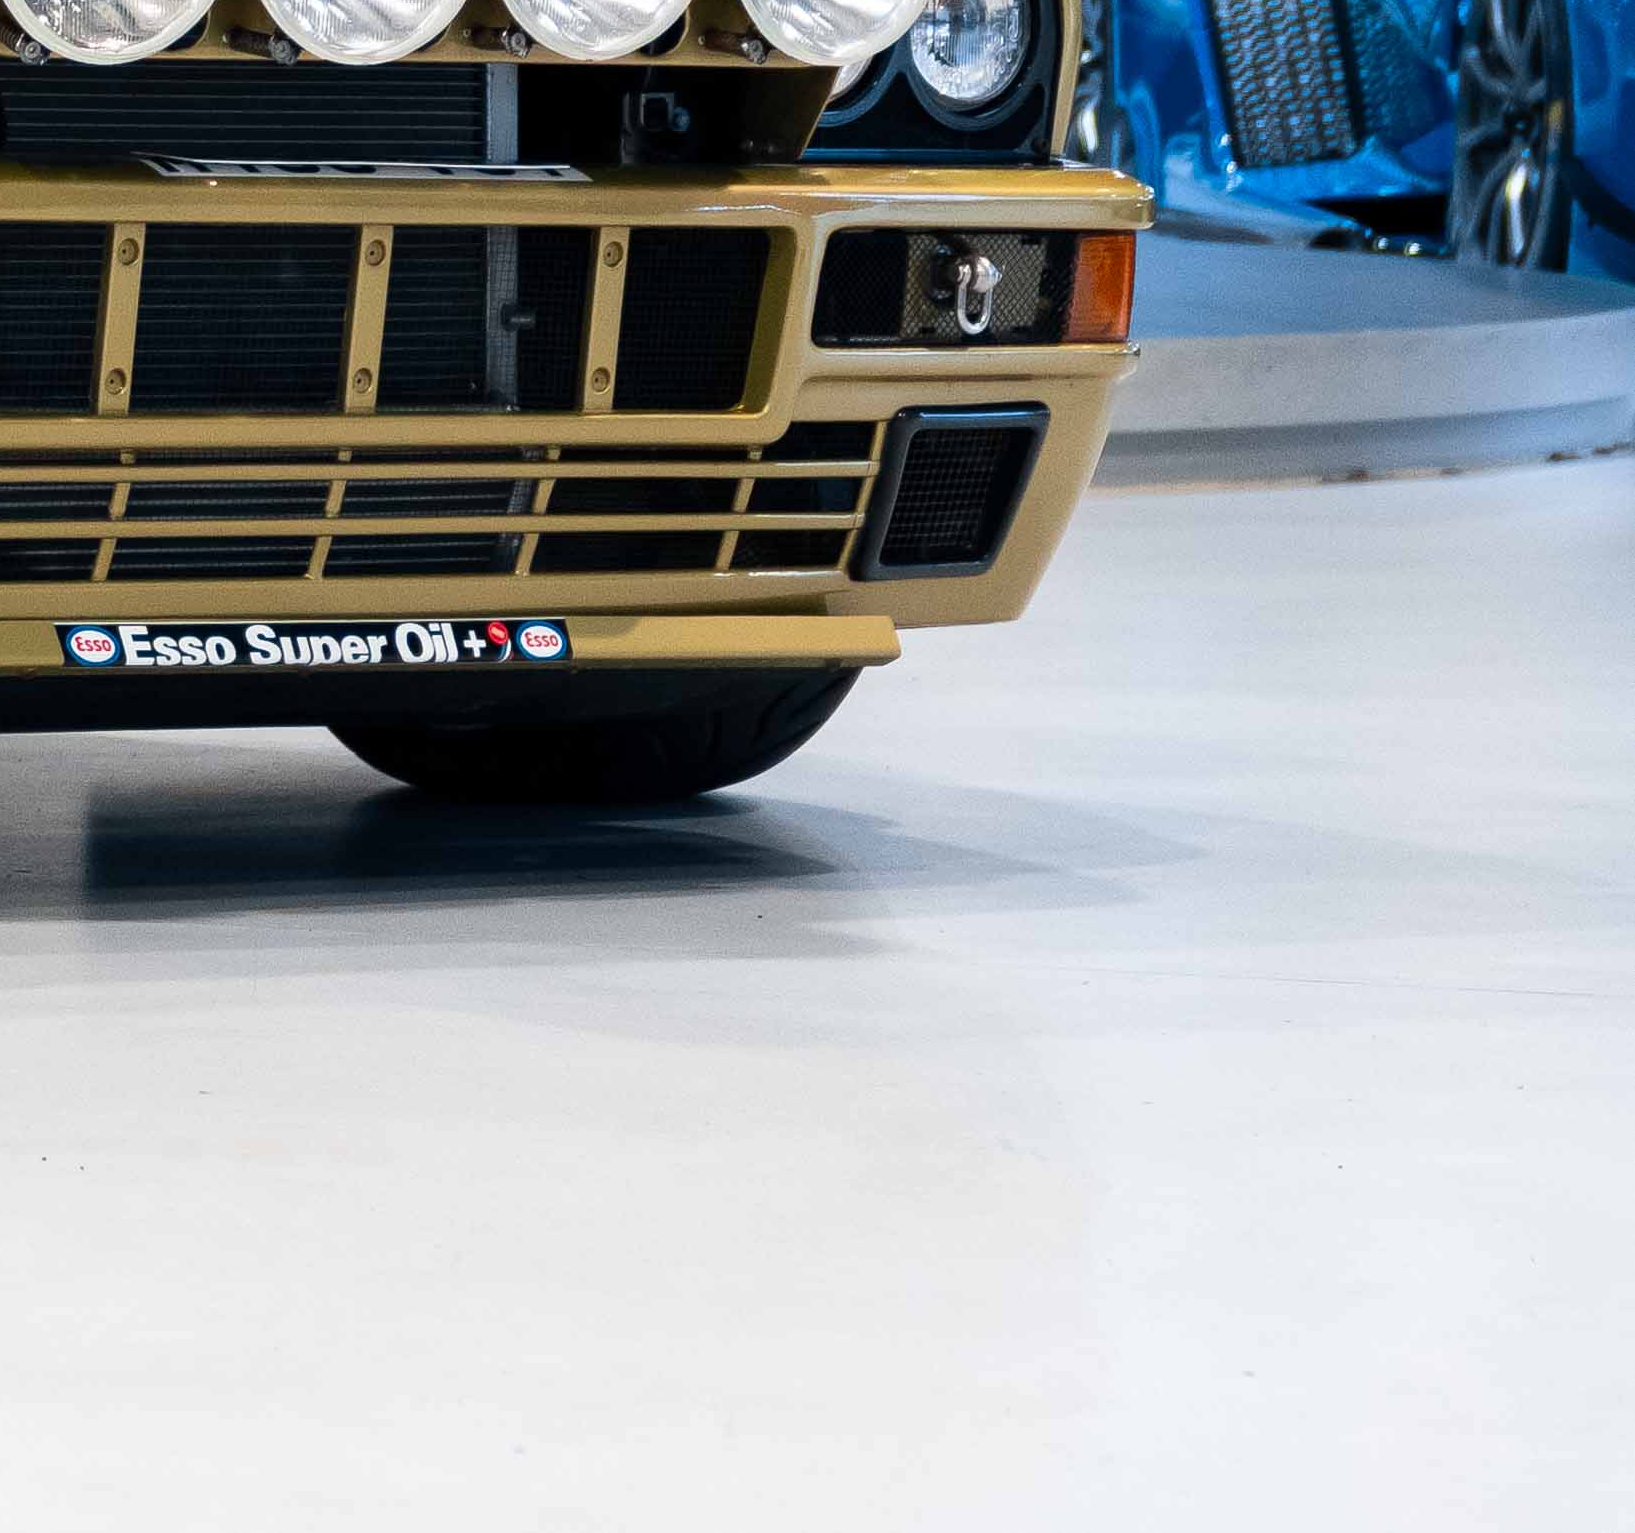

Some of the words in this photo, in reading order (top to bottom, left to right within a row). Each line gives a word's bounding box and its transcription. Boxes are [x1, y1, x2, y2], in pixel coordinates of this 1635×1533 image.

[75, 636, 111, 652] Esso
[119, 625, 236, 666] Esso
[245, 624, 387, 666] Super
[525, 631, 559, 647] Esso
